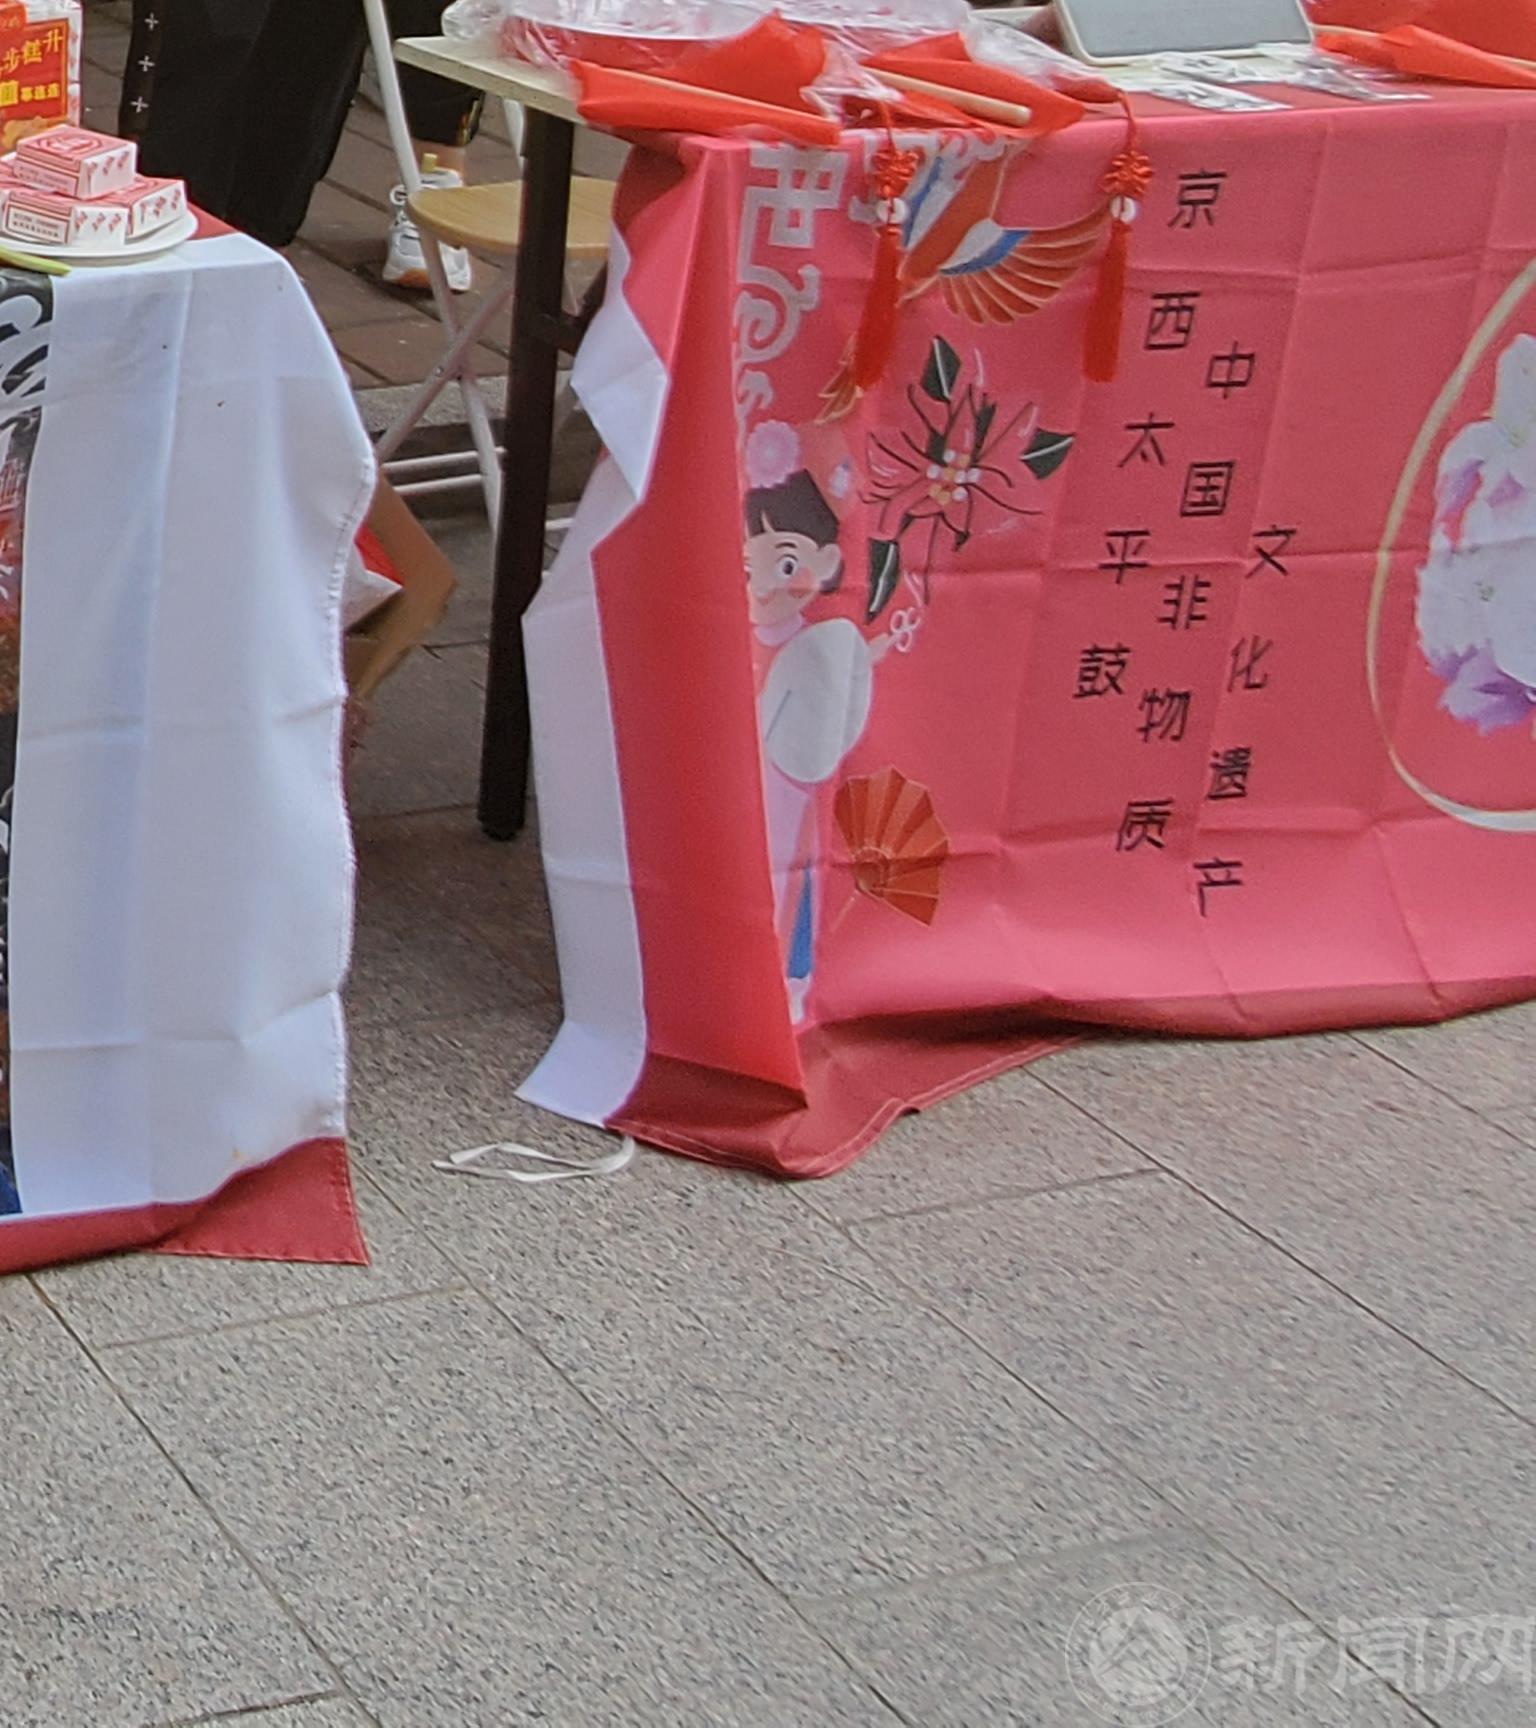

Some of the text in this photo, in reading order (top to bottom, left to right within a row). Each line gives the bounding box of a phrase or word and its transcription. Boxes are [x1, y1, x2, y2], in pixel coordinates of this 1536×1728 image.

[1072, 168, 1227, 702] 京西太平鼓
[1115, 341, 1256, 852] 中国非物质
[1192, 524, 1298, 917] 文化遗产
